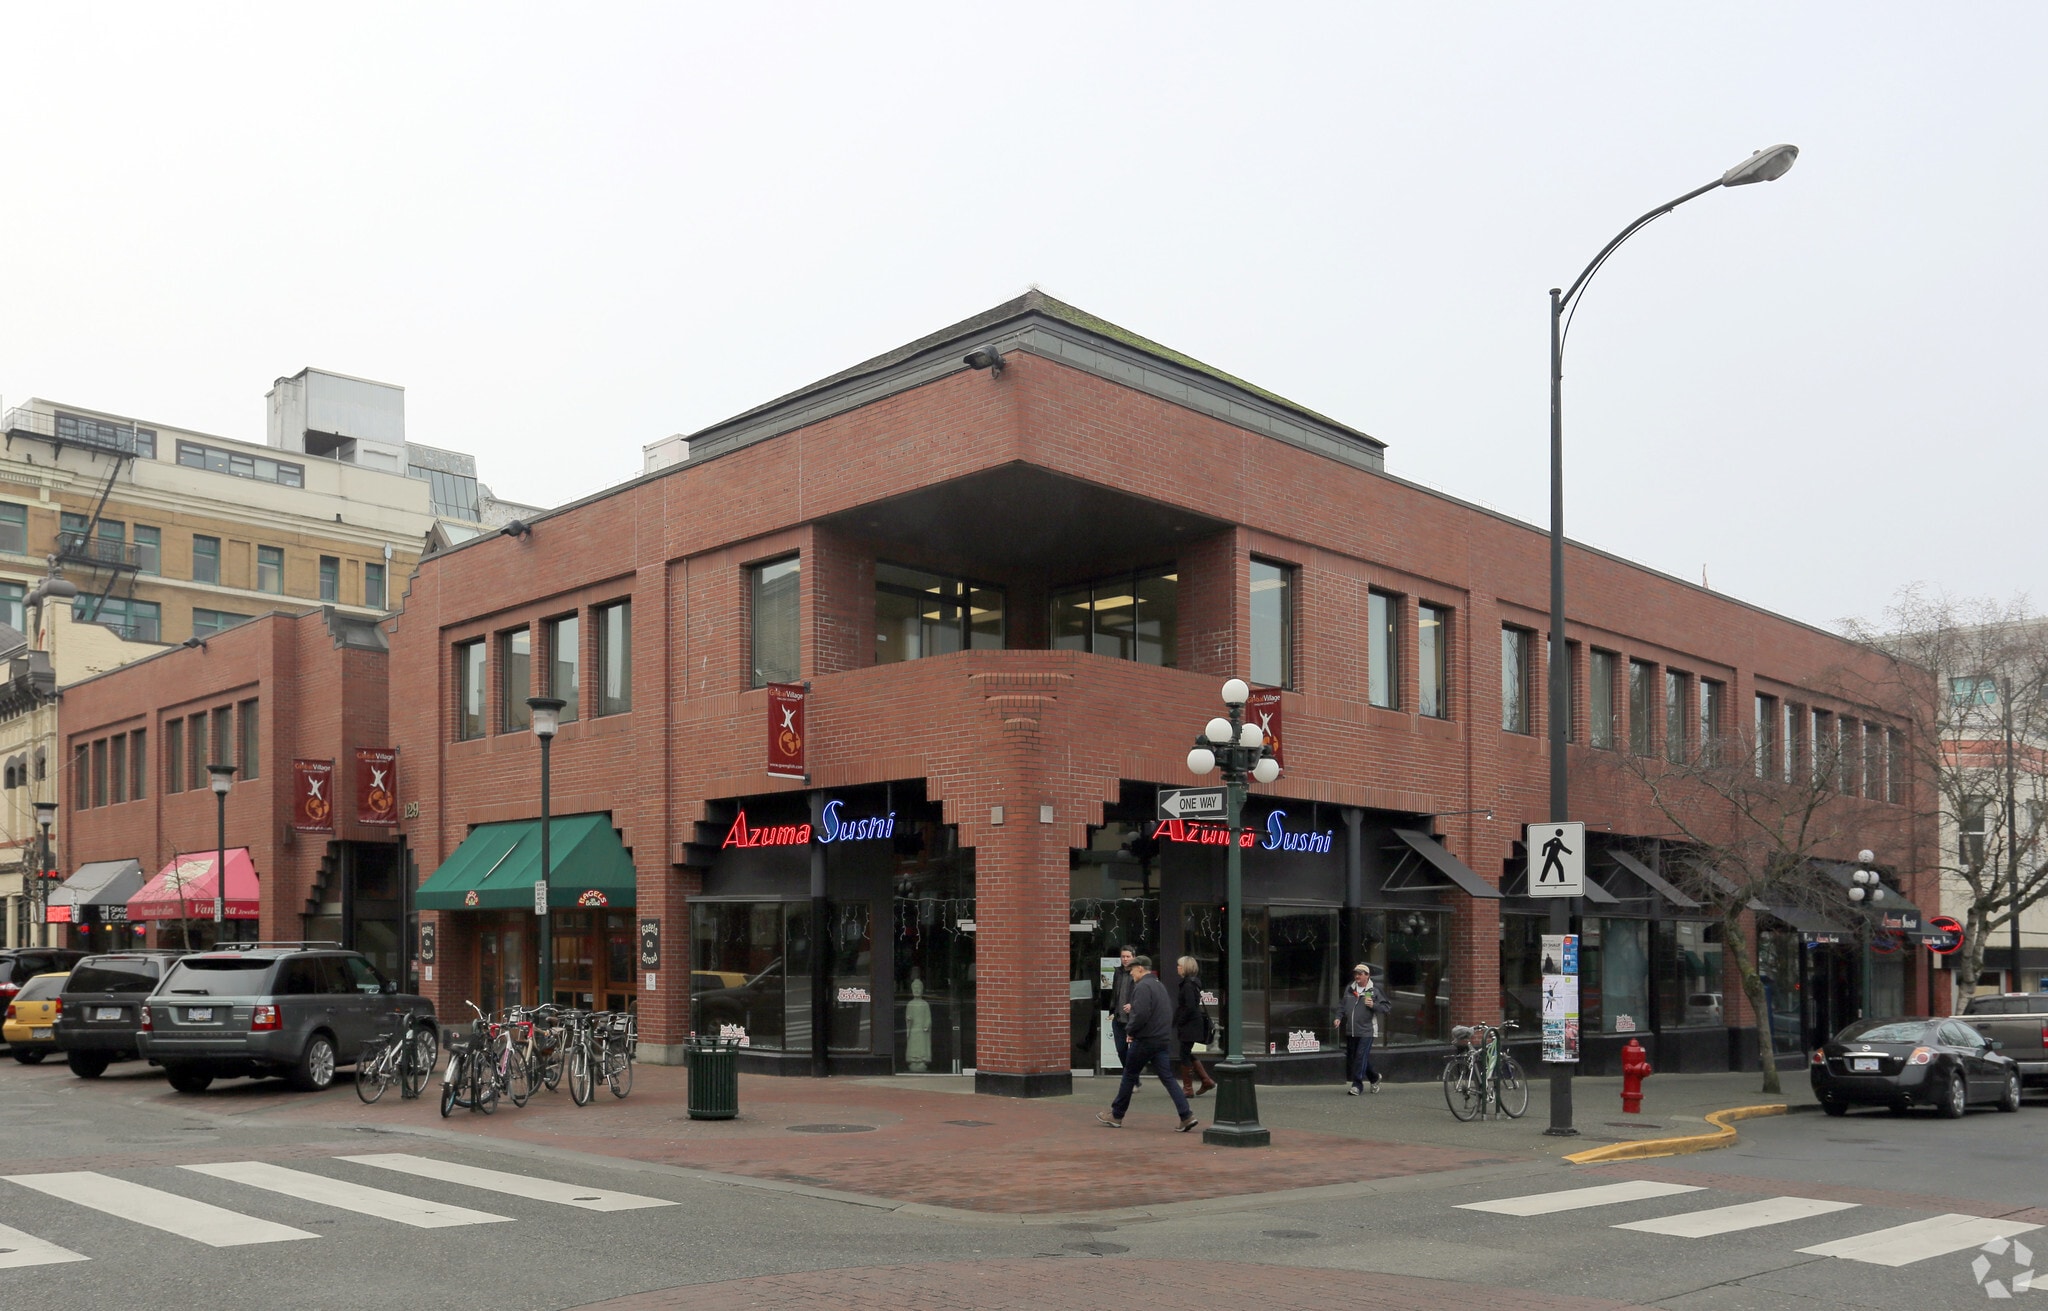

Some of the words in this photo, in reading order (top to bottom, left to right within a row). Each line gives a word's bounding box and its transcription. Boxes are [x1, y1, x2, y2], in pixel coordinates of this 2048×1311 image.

[404, 801, 420, 819] 129
[1180, 797, 1197, 810] ONE
[1200, 796, 1217, 809] WAY
[722, 810, 811, 849] Azuma
[817, 800, 896, 844] Sushi
[1261, 810, 1333, 853] Sushi
[578, 890, 607, 904] BAGELS
[194, 903, 237, 915] Vansa
[641, 923, 658, 936] Bagels
[646, 940, 653, 948] On
[642, 951, 658, 965] Broad
